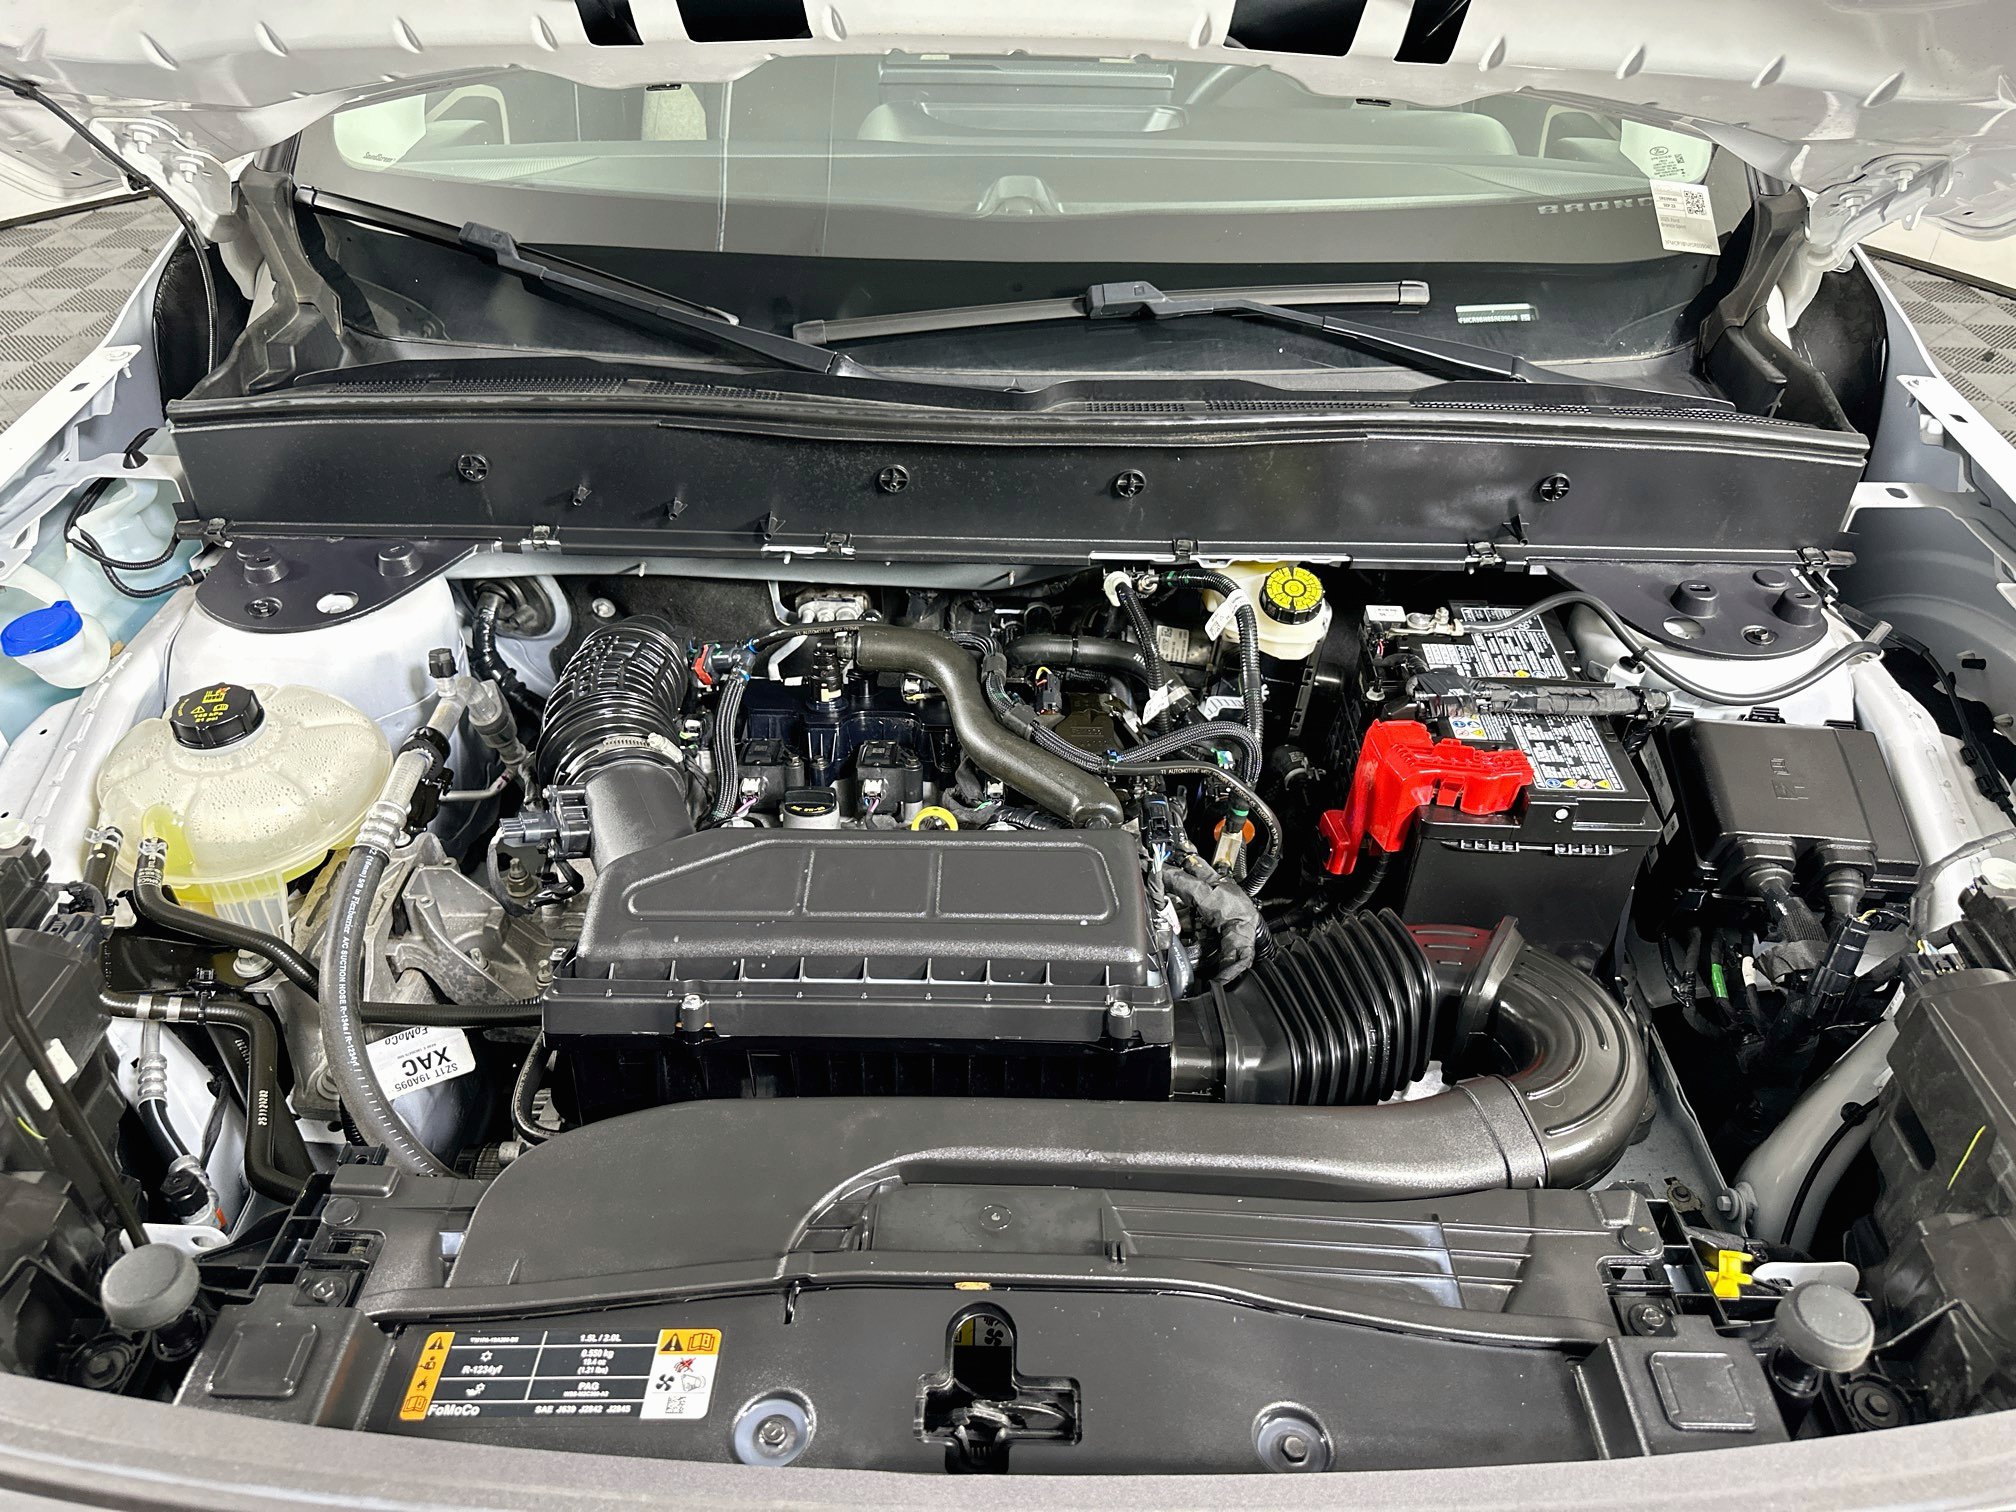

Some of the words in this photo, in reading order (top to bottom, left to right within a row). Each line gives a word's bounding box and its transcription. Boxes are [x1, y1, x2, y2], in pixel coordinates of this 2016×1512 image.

[1538, 197, 1652, 214] BRONC
[343, 895, 361, 934] Flexbarrier
[341, 937, 350, 950] A/C
[339, 949, 349, 983] SUCTION
[338, 983, 347, 1004] HOSE
[339, 1005, 349, 1032] R-134a
[384, 1027, 429, 1046] FoMoCo
[402, 1046, 452, 1077] XAC
[435, 1063, 458, 1078] SZ1T
[395, 1072, 431, 1092] 19A095
[580, 1333, 598, 1343] 1.5L
[602, 1332, 622, 1343] 2.0L
[602, 1348, 614, 1360] kg
[461, 1364, 503, 1376] R-1234yf
[578, 1381, 599, 1391] PAG
[428, 1403, 480, 1417] FoMoCo
[535, 1405, 553, 1414] SAE
[555, 1405, 576, 1414] J639
